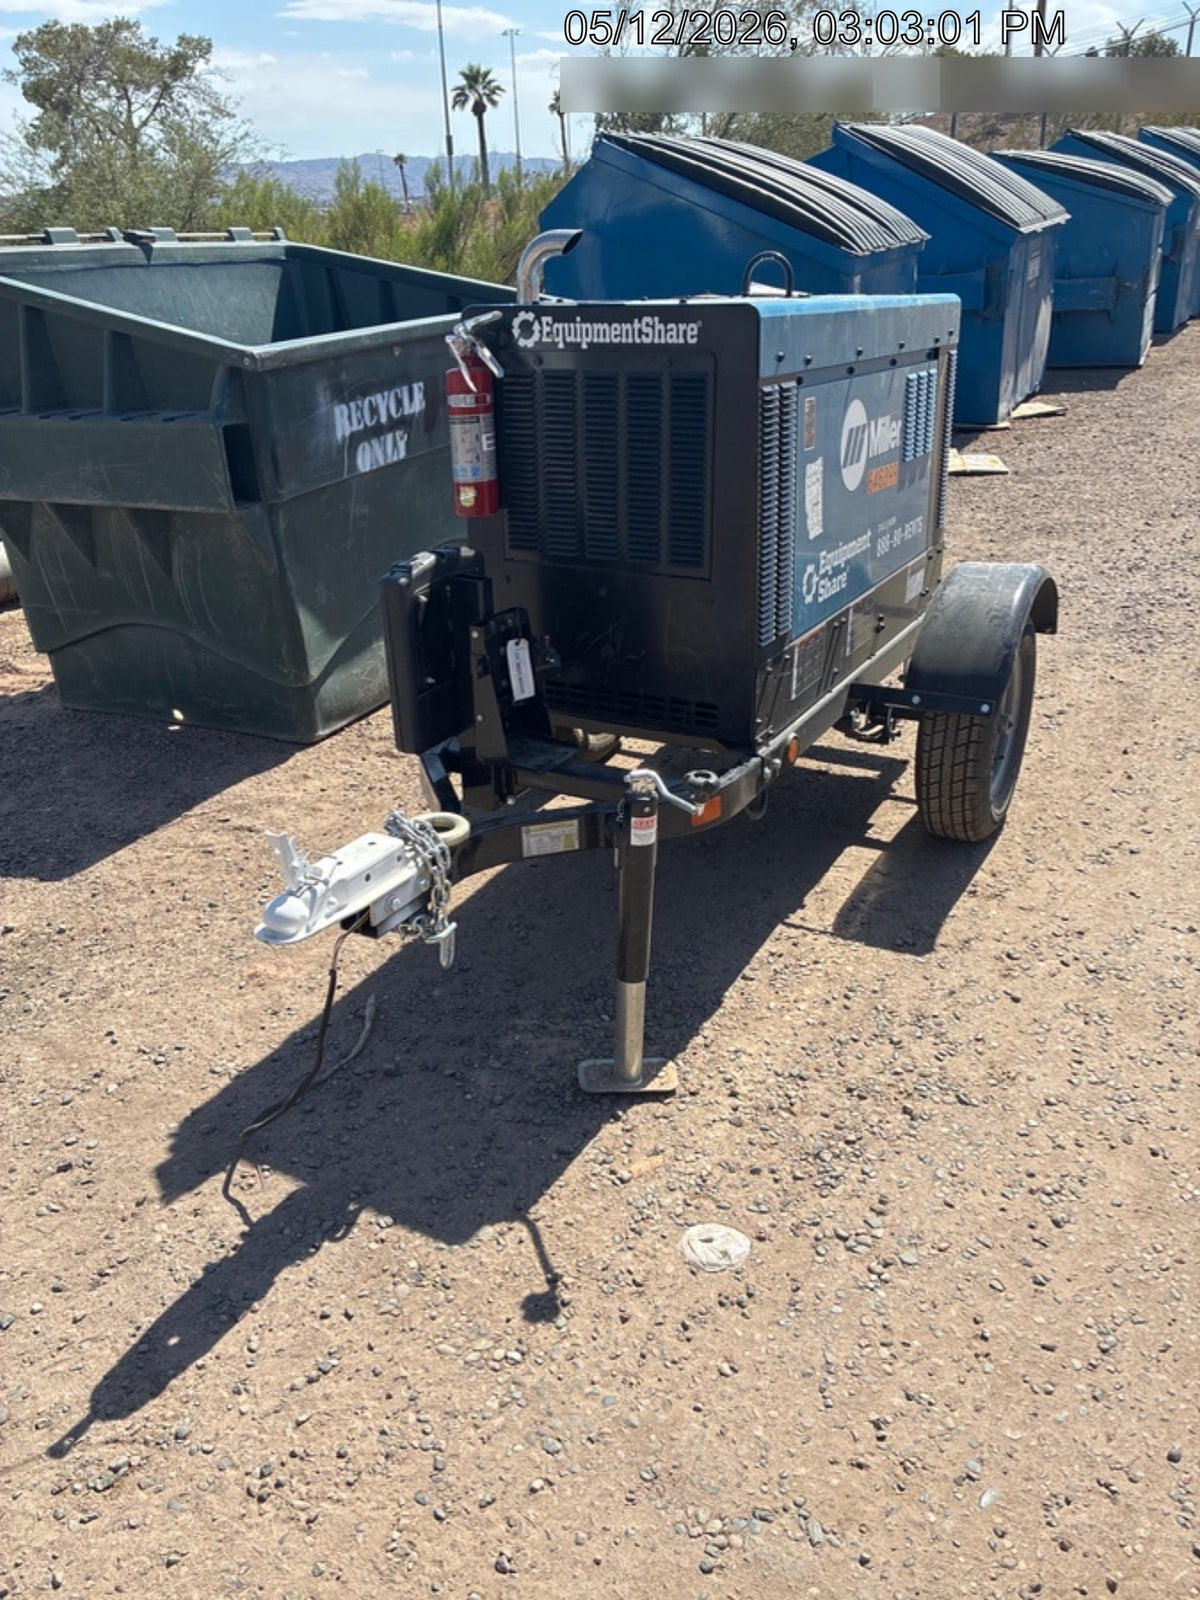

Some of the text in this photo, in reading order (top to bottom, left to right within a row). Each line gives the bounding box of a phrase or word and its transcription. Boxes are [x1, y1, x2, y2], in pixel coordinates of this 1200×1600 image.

[333, 381, 426, 443] RECYCLE
[356, 427, 408, 473] ONLY
[868, 415, 903, 459] Miller
[818, 529, 872, 576] Equipment
[817, 571, 848, 604] Share
